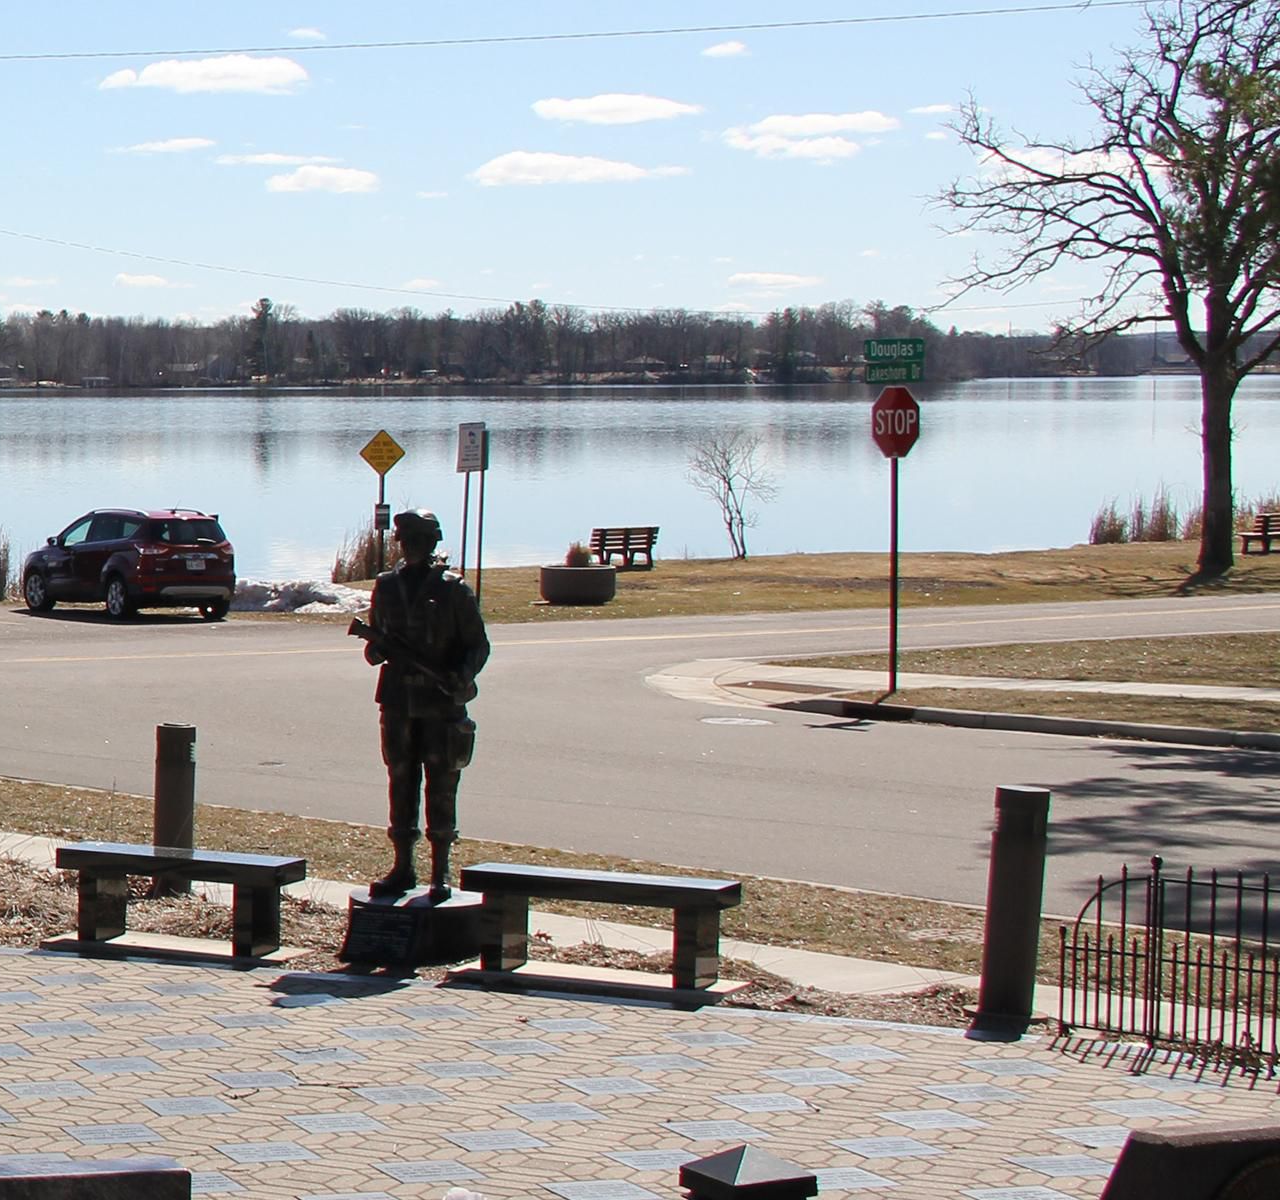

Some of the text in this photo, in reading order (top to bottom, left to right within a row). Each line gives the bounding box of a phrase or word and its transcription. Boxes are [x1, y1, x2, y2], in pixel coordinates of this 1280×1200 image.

[870, 341, 914, 359] Douglas
[866, 363, 921, 381] Lakeshore Dr
[875, 409, 917, 435] STOP
